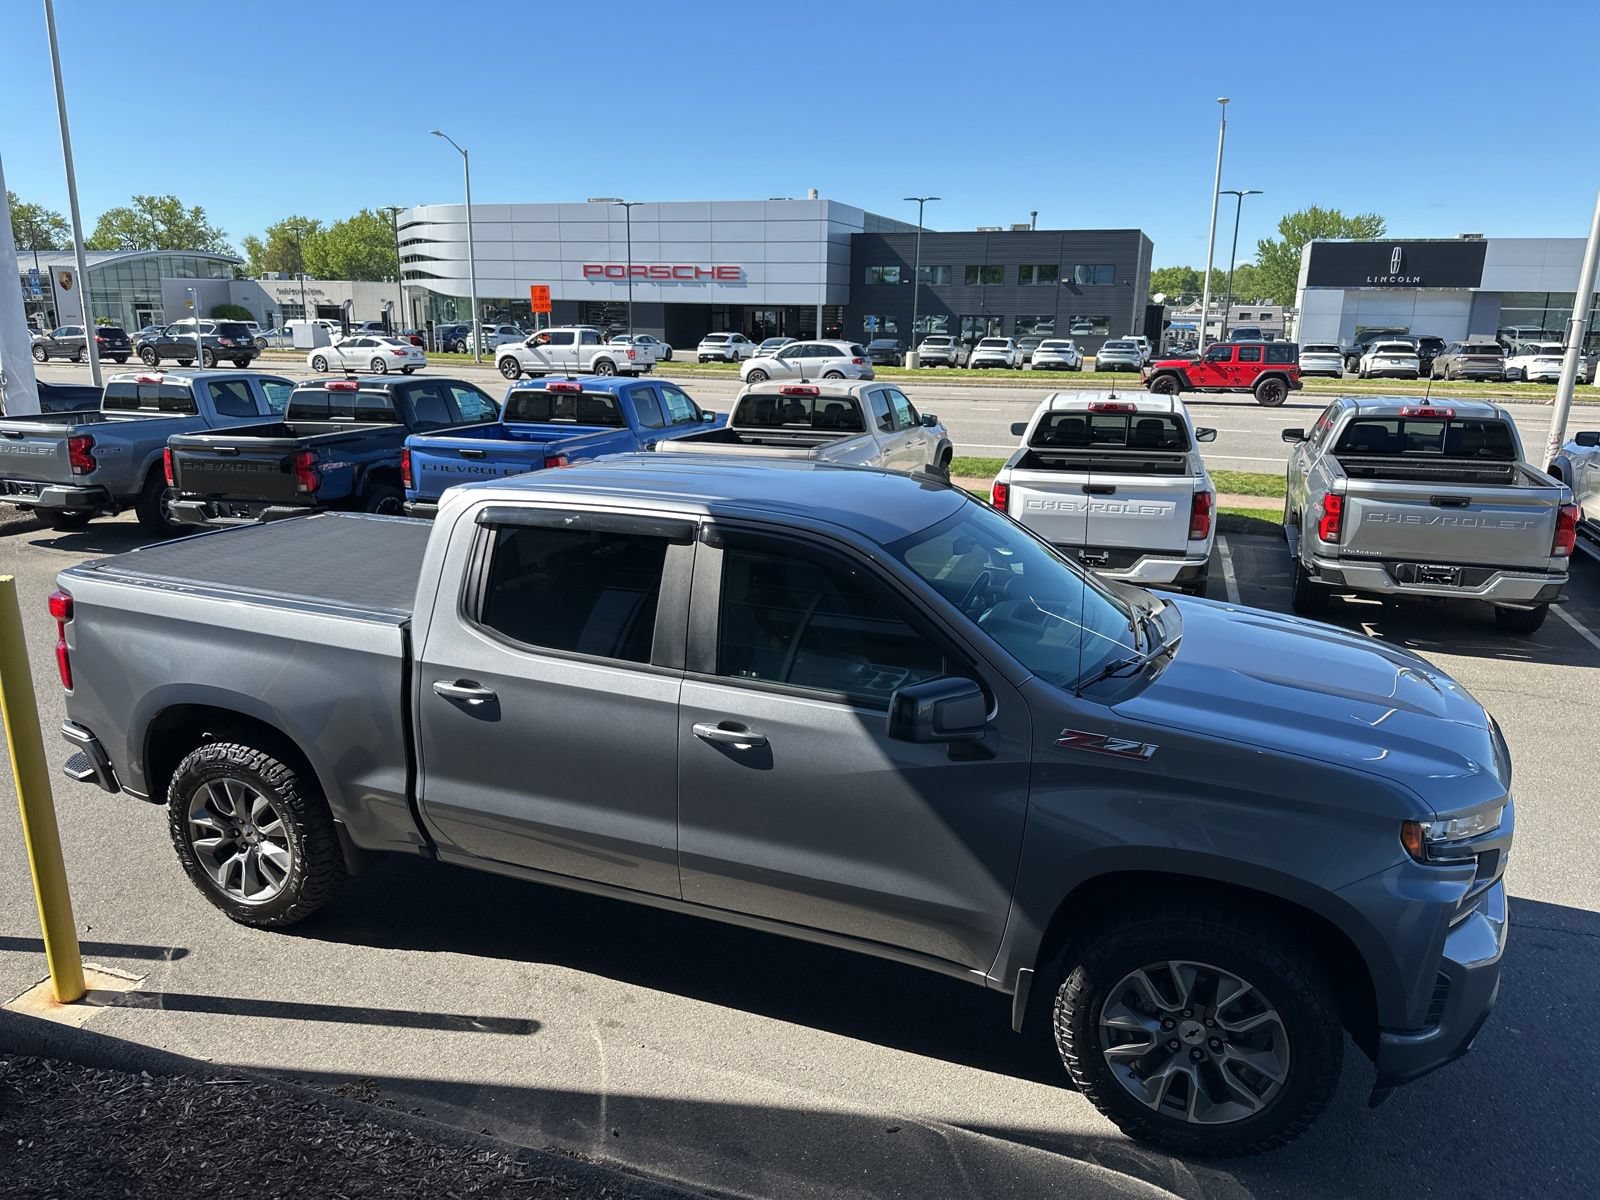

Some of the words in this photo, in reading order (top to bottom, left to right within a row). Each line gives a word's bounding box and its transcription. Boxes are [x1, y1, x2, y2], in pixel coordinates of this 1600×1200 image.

[583, 264, 740, 280] PORSCHE
[183, 461, 281, 473] CHEVROLET
[1026, 500, 1172, 517] CHEVROLET
[1365, 512, 1535, 530] CHEVROLET
[1054, 728, 1159, 762] Z71
